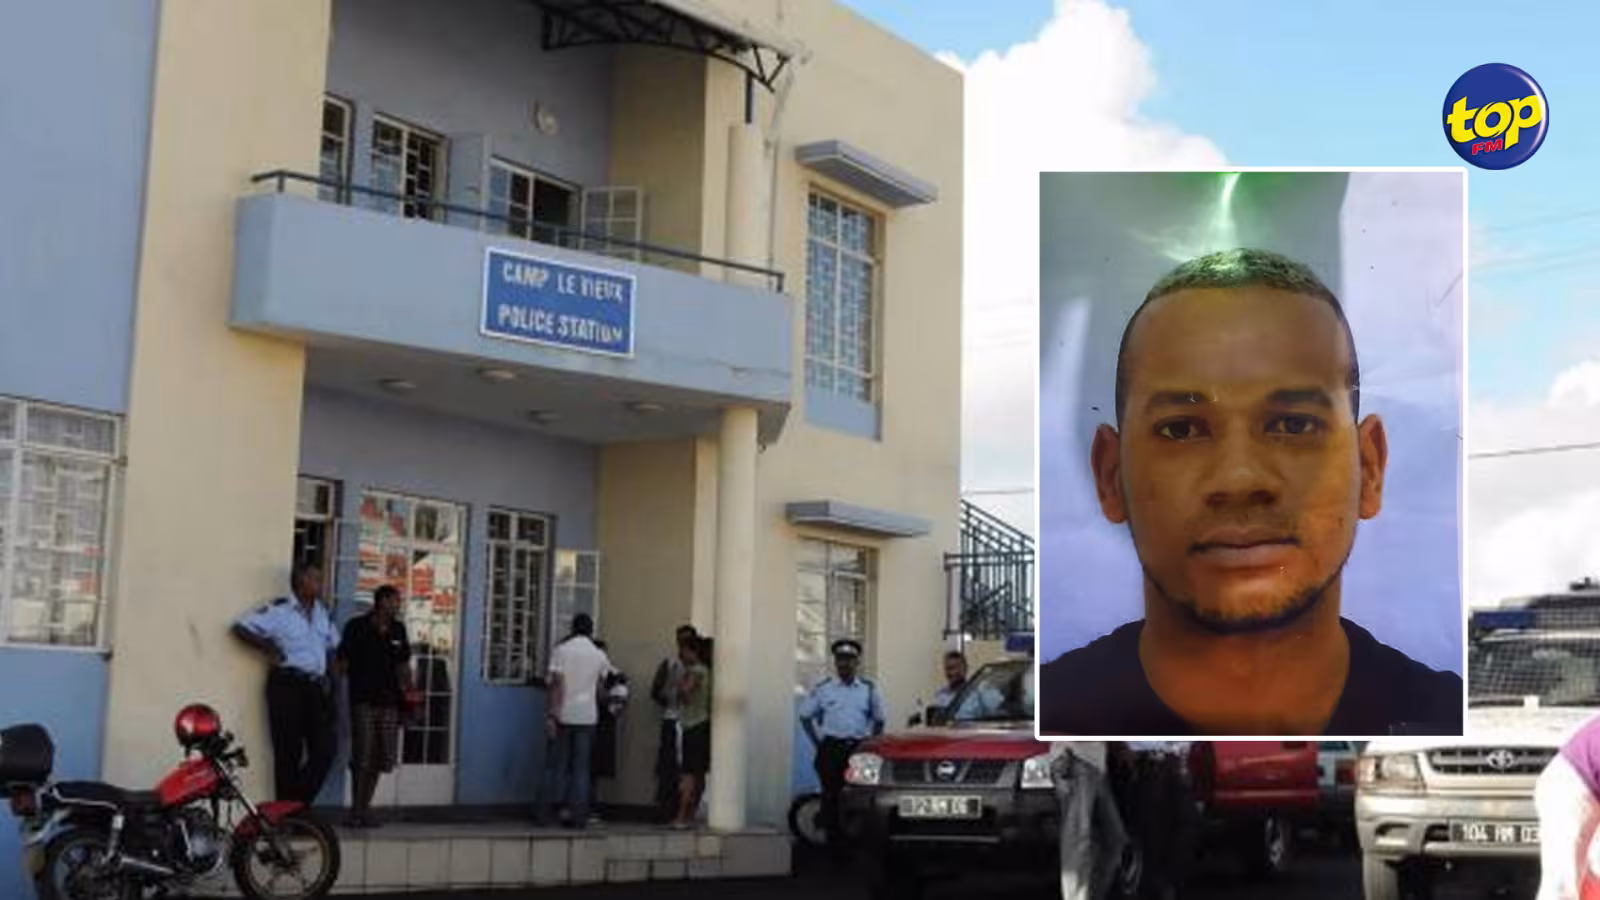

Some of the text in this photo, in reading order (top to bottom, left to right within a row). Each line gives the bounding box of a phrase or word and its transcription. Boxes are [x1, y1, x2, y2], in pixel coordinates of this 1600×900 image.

[503, 261, 623, 301] CAMP LE VIEUX
[498, 303, 623, 342] POLICE STATION
